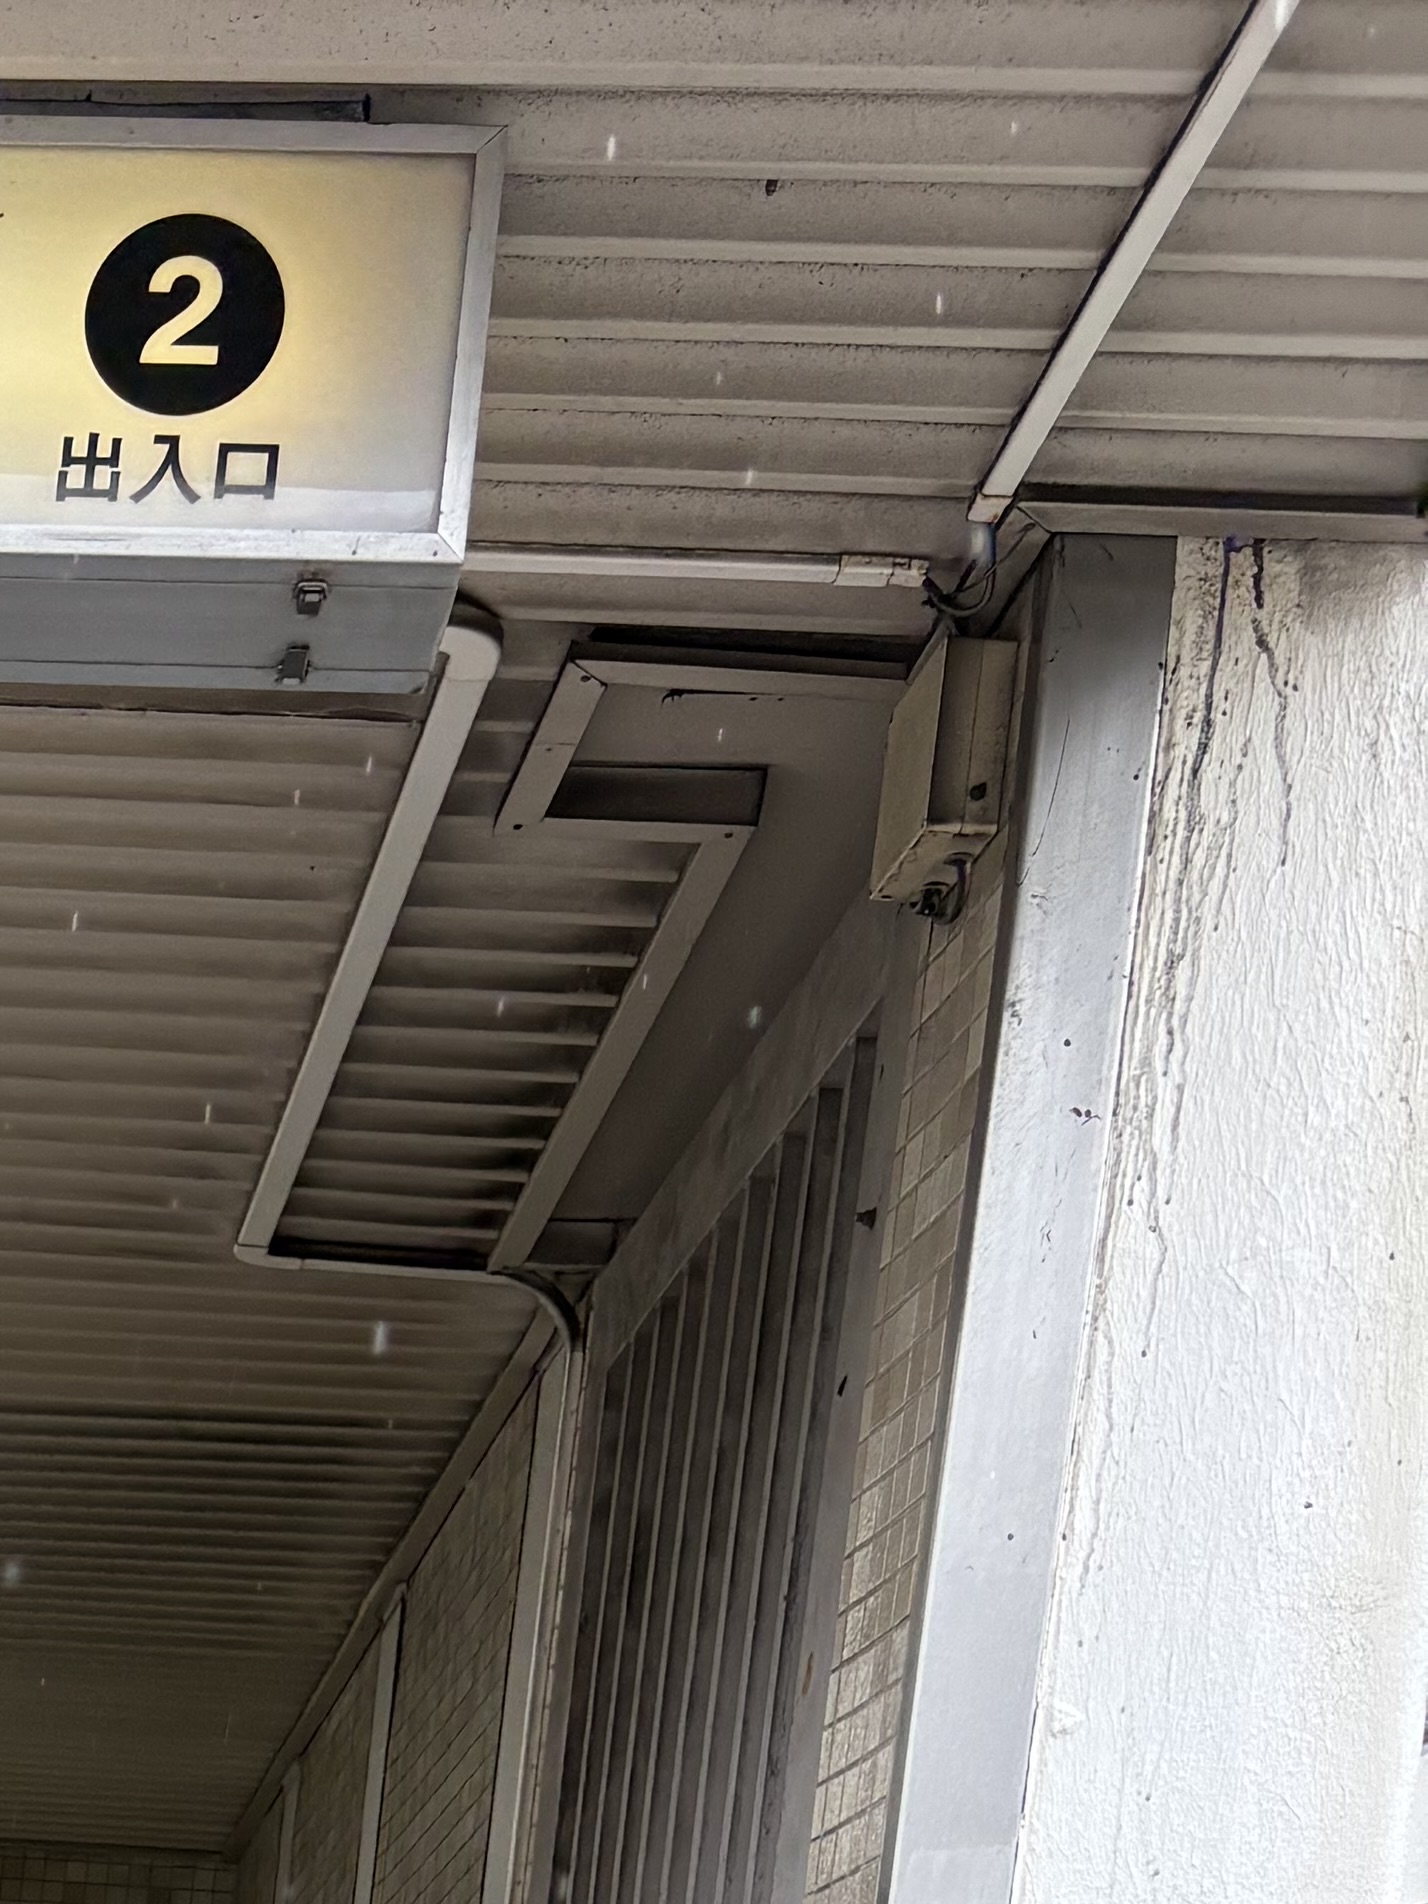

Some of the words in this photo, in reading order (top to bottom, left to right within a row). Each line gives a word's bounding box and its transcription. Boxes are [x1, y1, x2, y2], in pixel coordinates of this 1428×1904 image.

[139, 255, 223, 366] 2
[55, 431, 280, 505] 出入口
